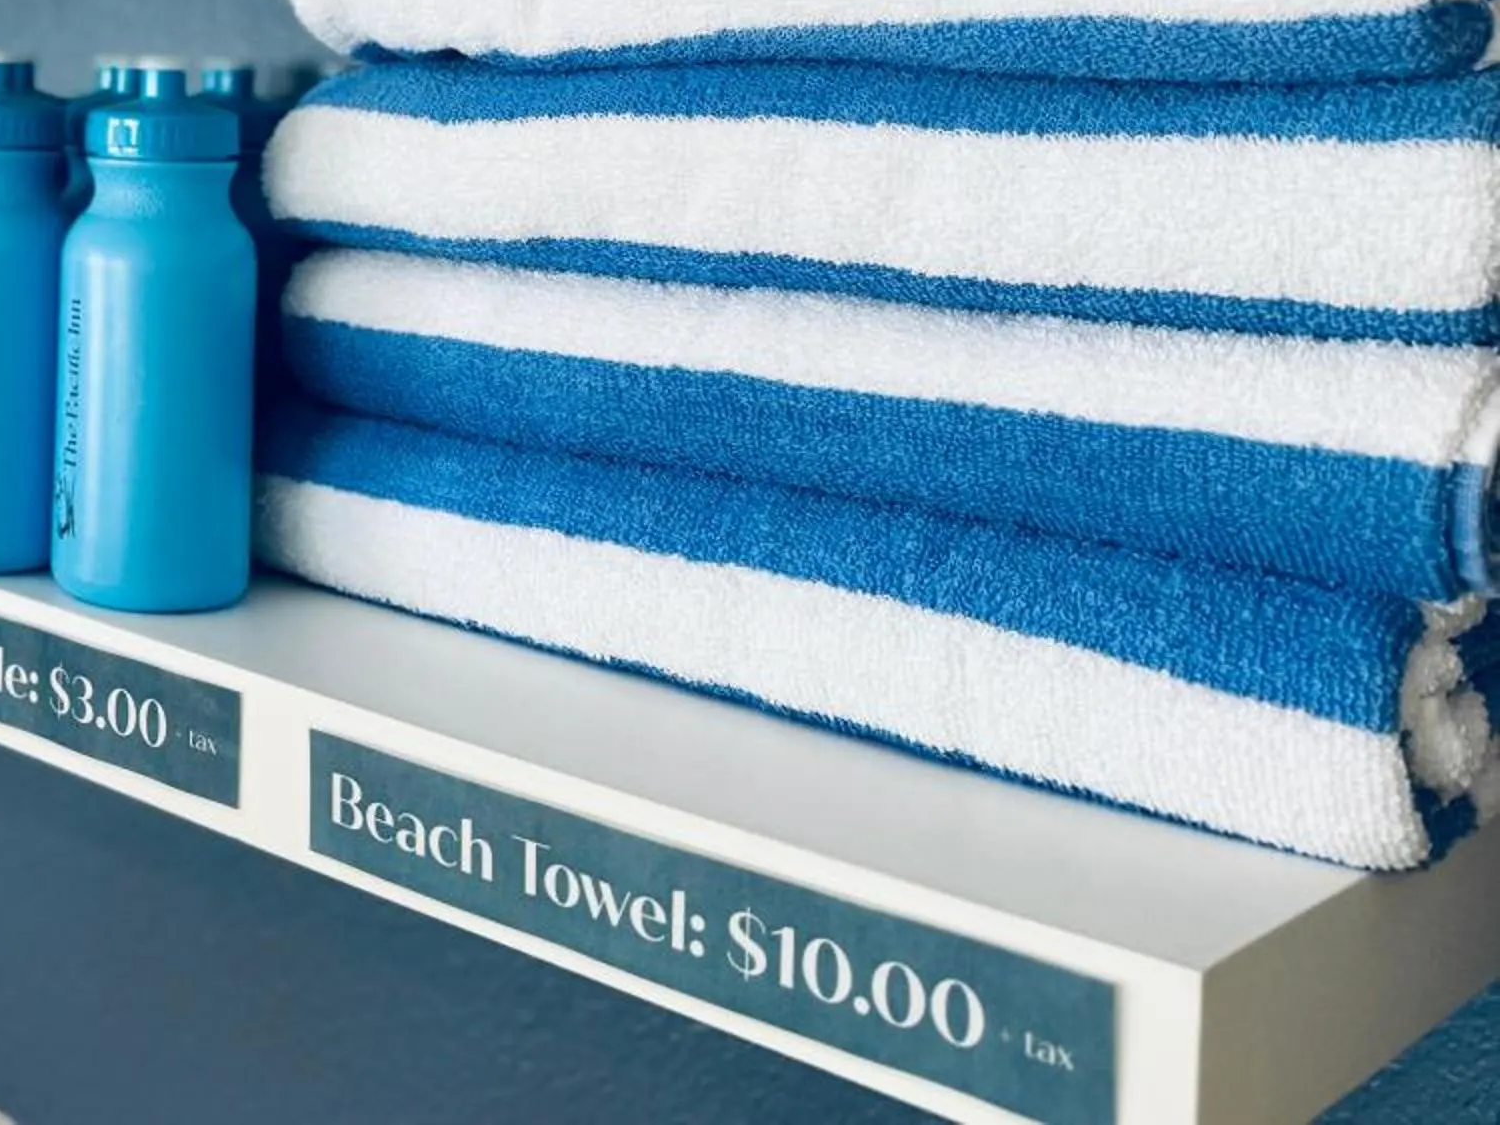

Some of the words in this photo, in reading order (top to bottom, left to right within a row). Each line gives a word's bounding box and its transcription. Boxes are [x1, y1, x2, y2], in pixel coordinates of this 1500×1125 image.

[67, 296, 82, 336] Inn
[63, 422, 79, 468] The
[49, 660, 168, 749] $3.00
[188, 727, 219, 757] tax
[329, 771, 493, 881] Beach
[512, 833, 706, 959] Towel:
[726, 906, 986, 1050] $10.00
[1023, 1029, 1075, 1072] tax
